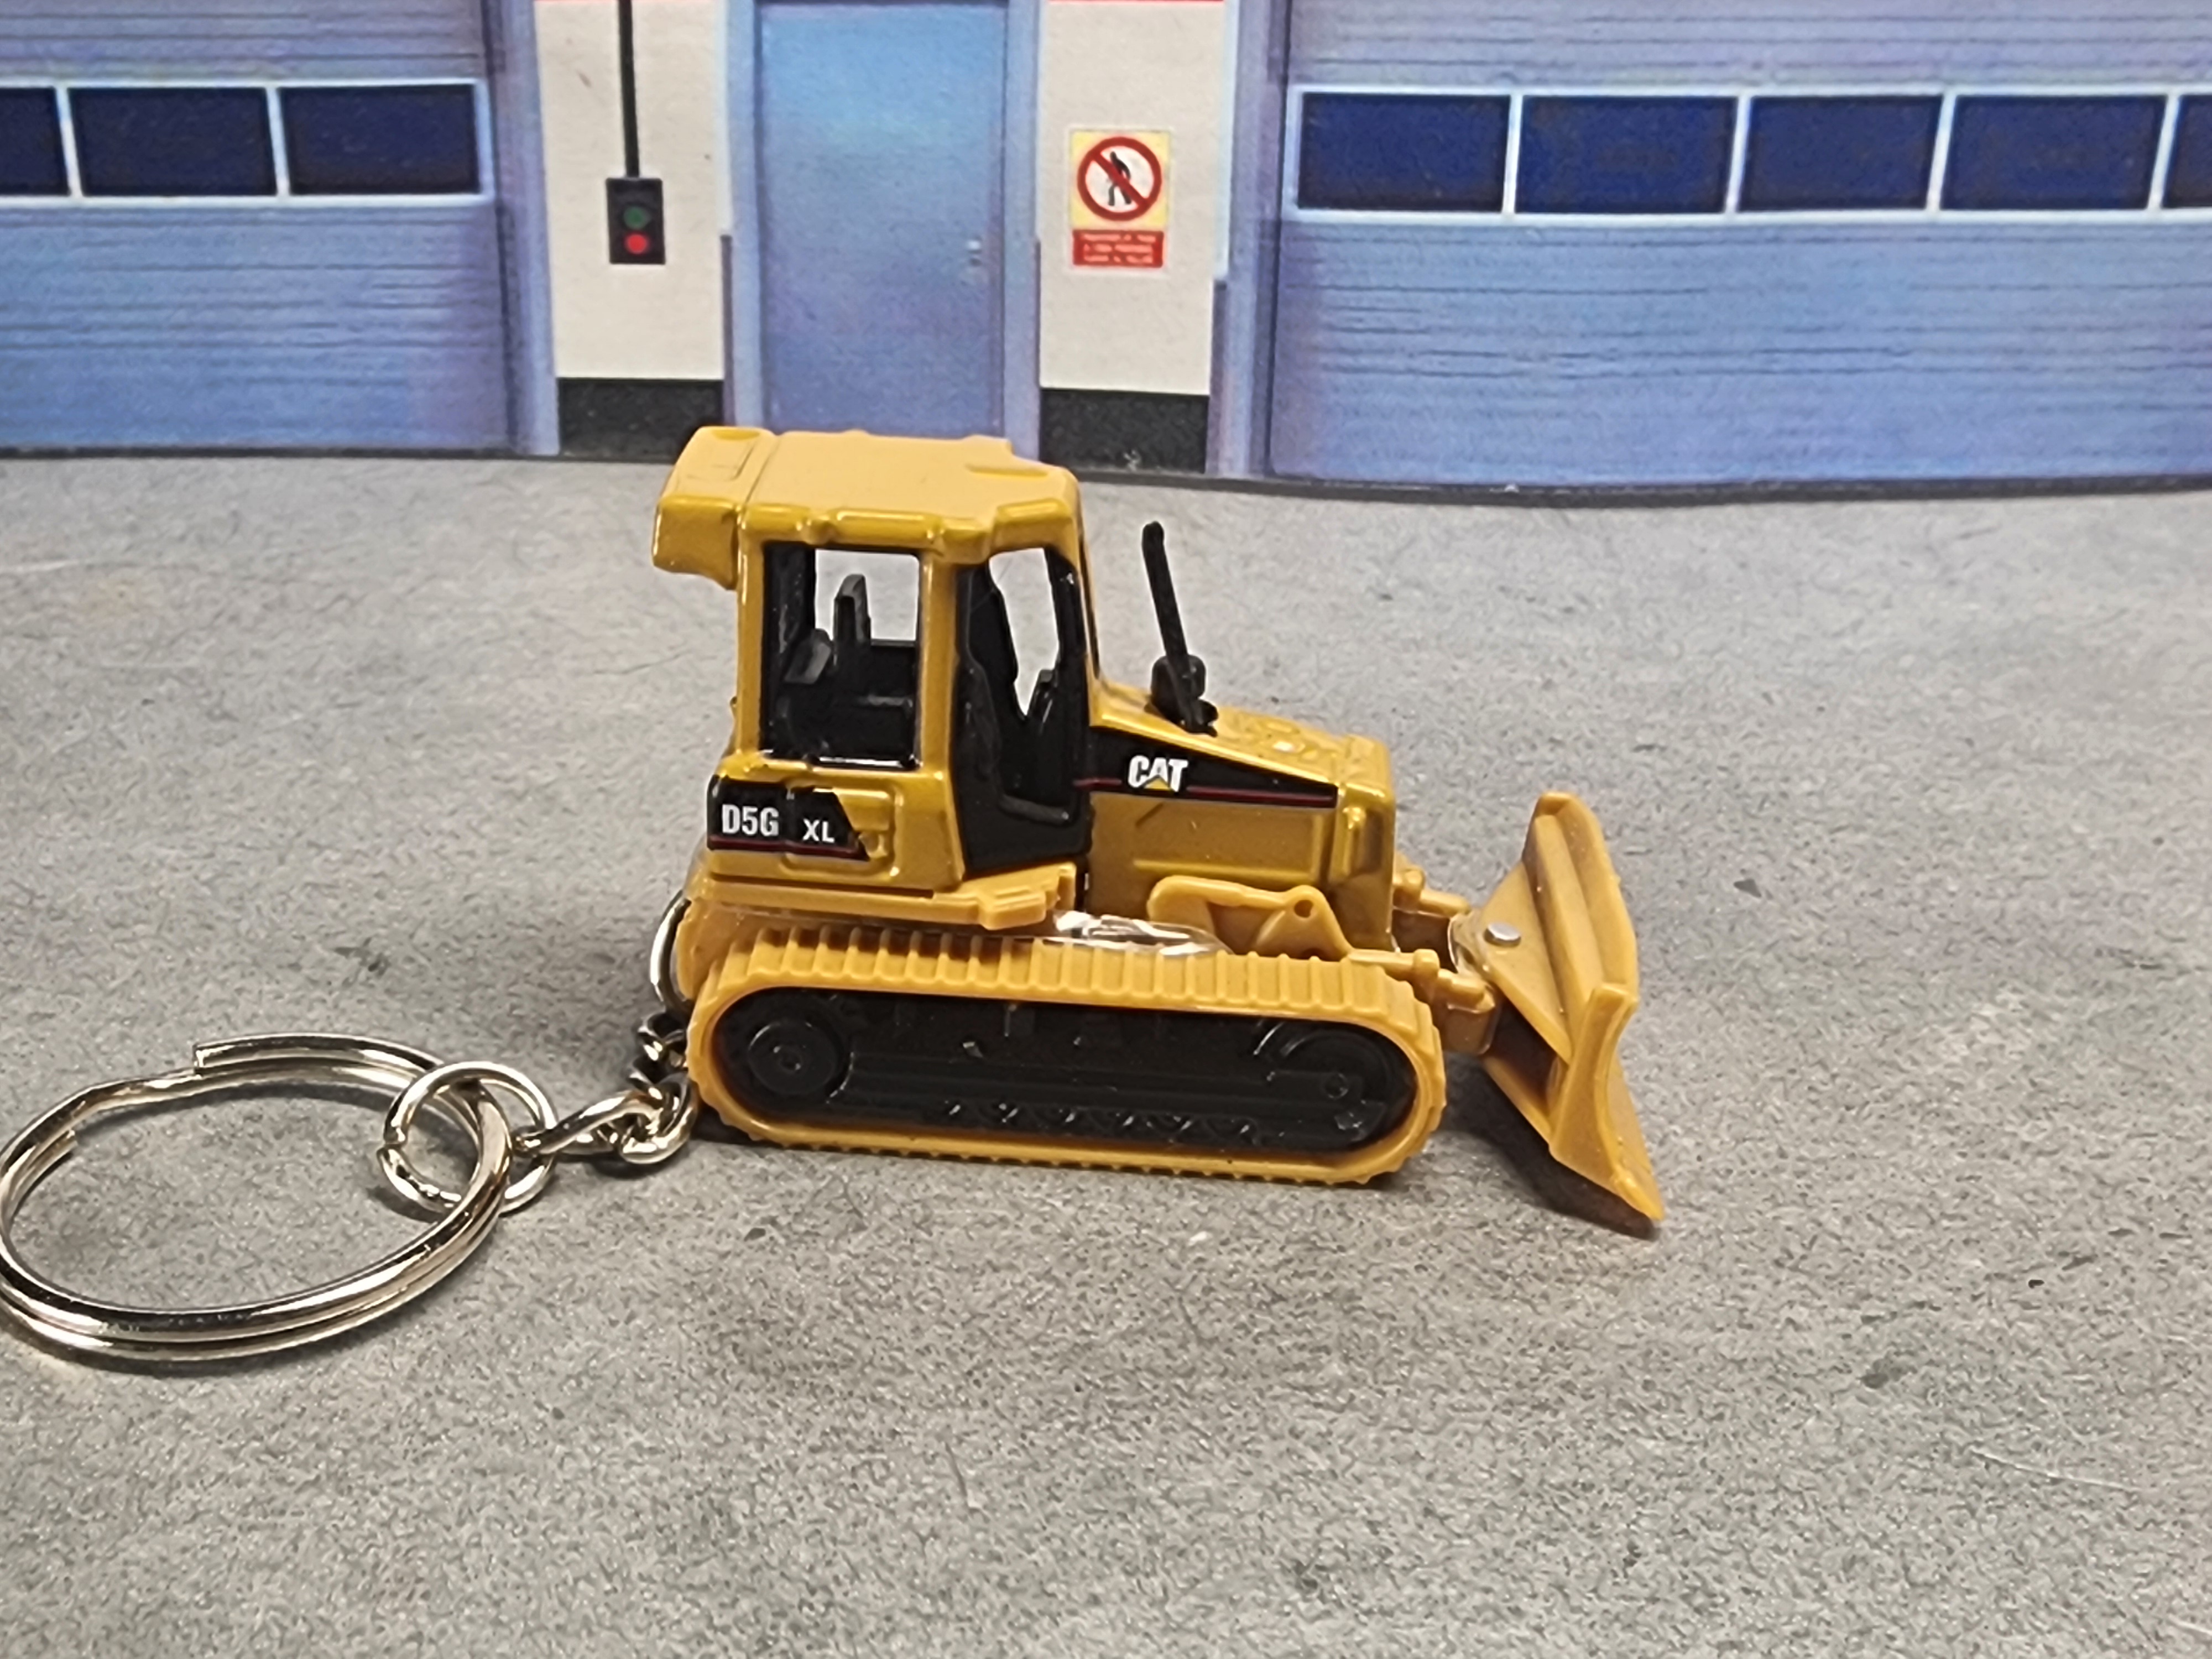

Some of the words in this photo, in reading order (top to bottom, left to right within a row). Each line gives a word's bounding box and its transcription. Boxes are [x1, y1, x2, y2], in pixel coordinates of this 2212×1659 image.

[1128, 755, 1188, 792] CAT
[721, 804, 779, 837] D5G
[802, 818, 835, 843] XL
